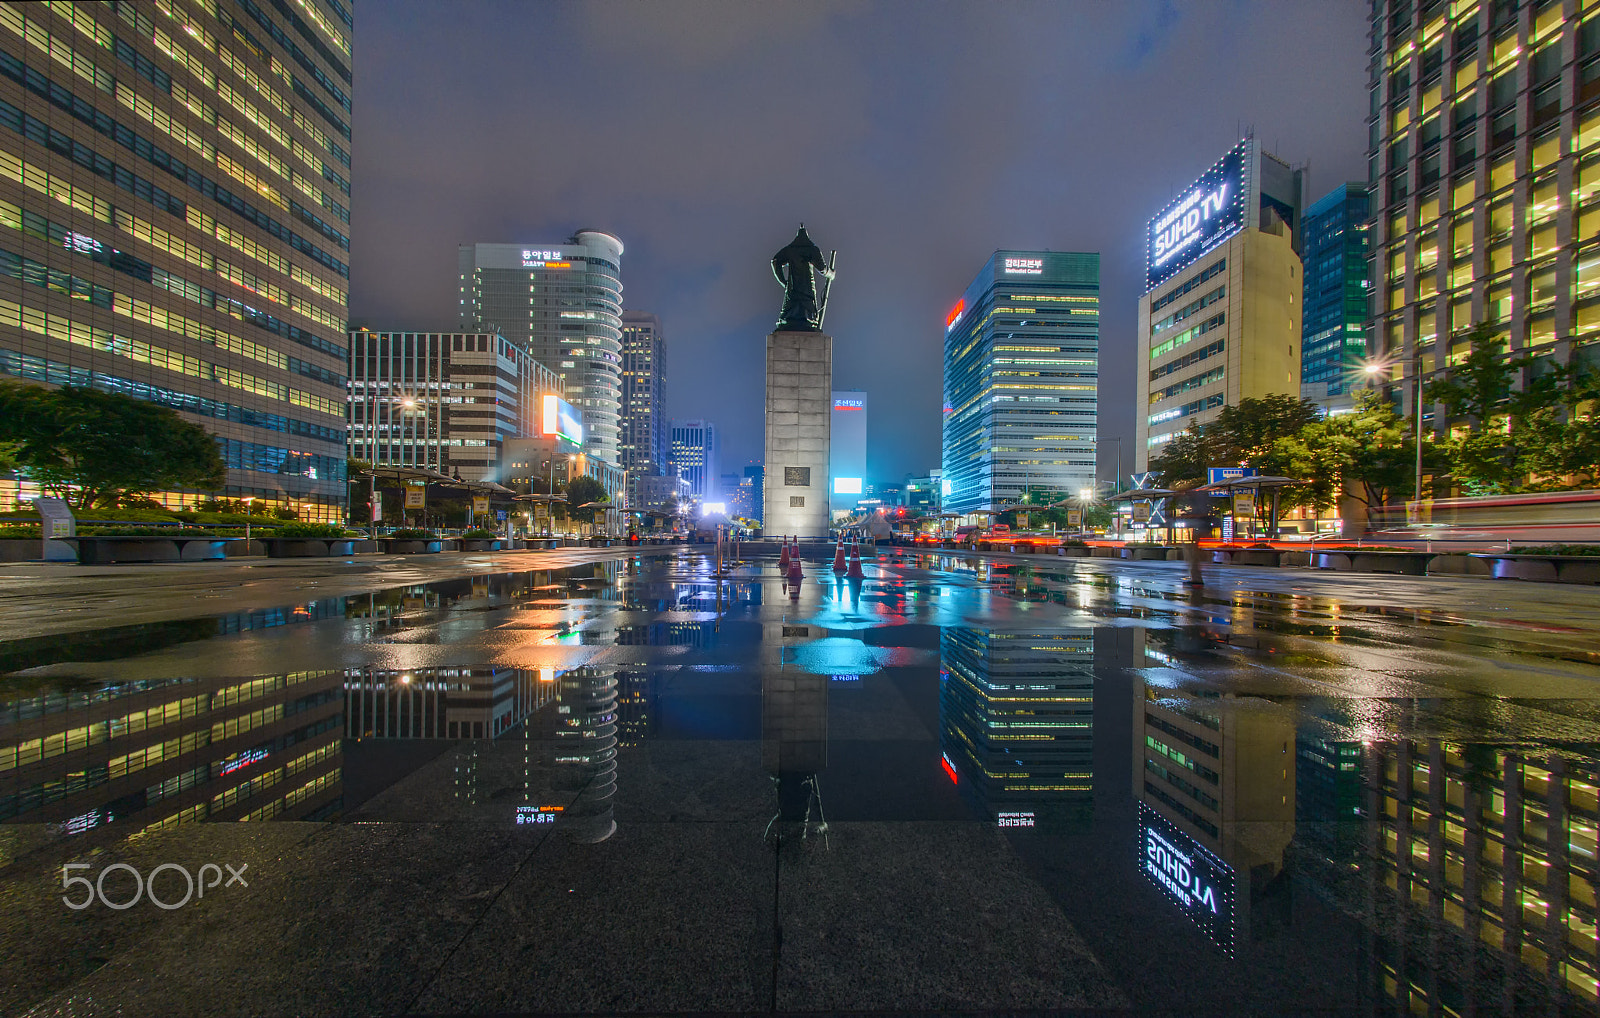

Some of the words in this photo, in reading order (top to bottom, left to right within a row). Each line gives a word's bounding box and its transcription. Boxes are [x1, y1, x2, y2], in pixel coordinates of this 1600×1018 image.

[1155, 189, 1201, 234] SAMSUNG
[1155, 208, 1200, 257] SUHD
[1201, 183, 1227, 220] TV
[522, 250, 562, 260] 동아일보
[1005, 259, 1042, 268] 감리교본부
